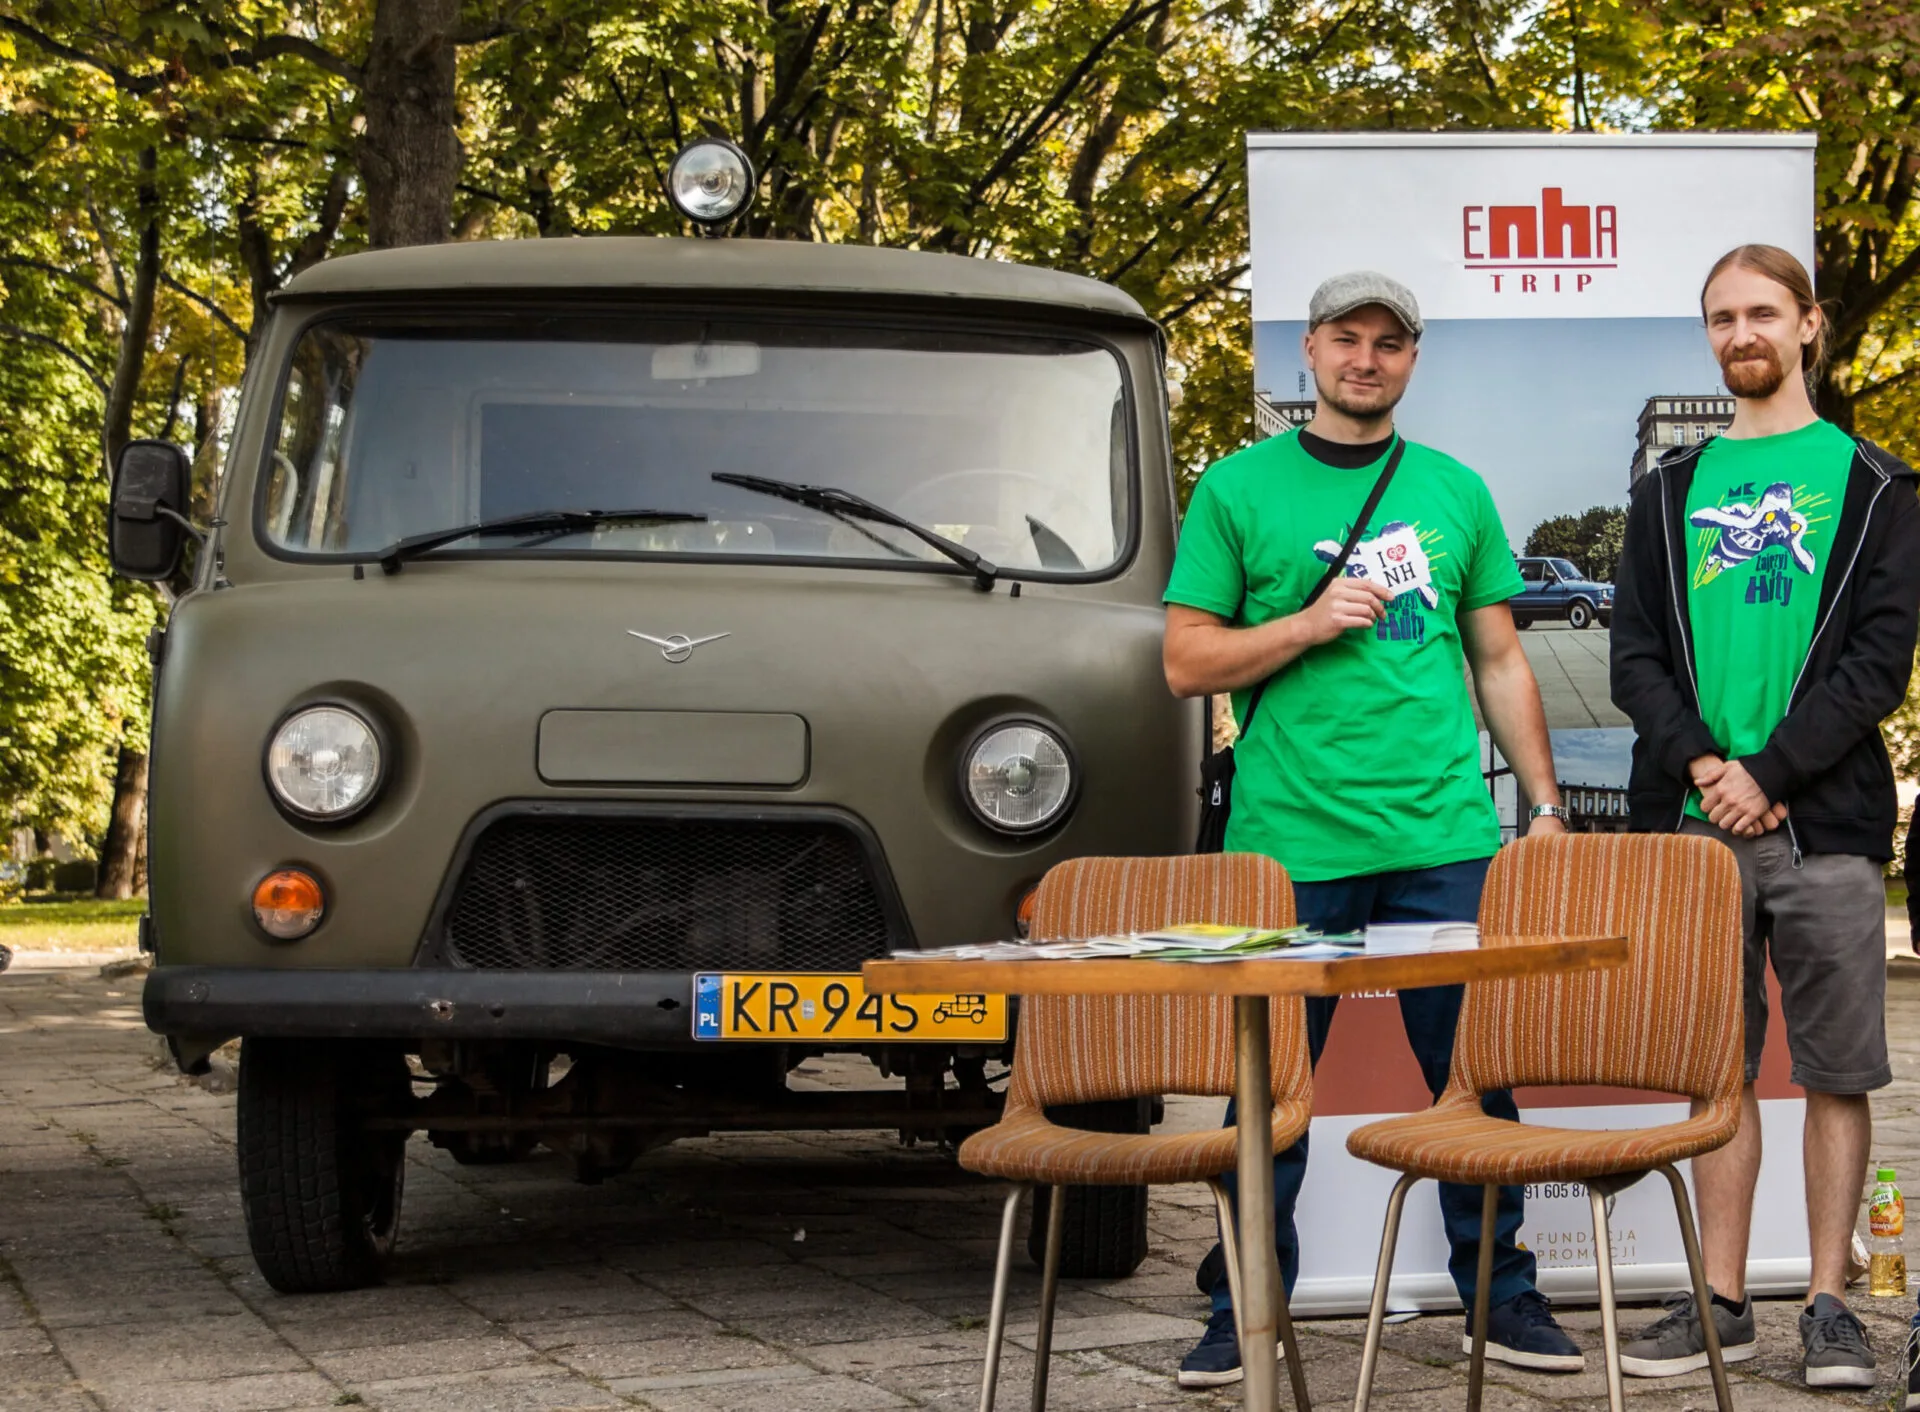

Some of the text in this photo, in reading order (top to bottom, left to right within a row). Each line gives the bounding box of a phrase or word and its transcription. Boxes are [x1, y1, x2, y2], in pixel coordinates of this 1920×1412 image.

[1490, 273, 1592, 293] TRIP
[1376, 551, 1387, 568] I
[1383, 561, 1417, 588] NH
[732, 982, 798, 1033] KR
[700, 1013, 719, 1027] PL
[1544, 1183, 1568, 1199] 605
[1572, 1183, 1590, 1199] 87
